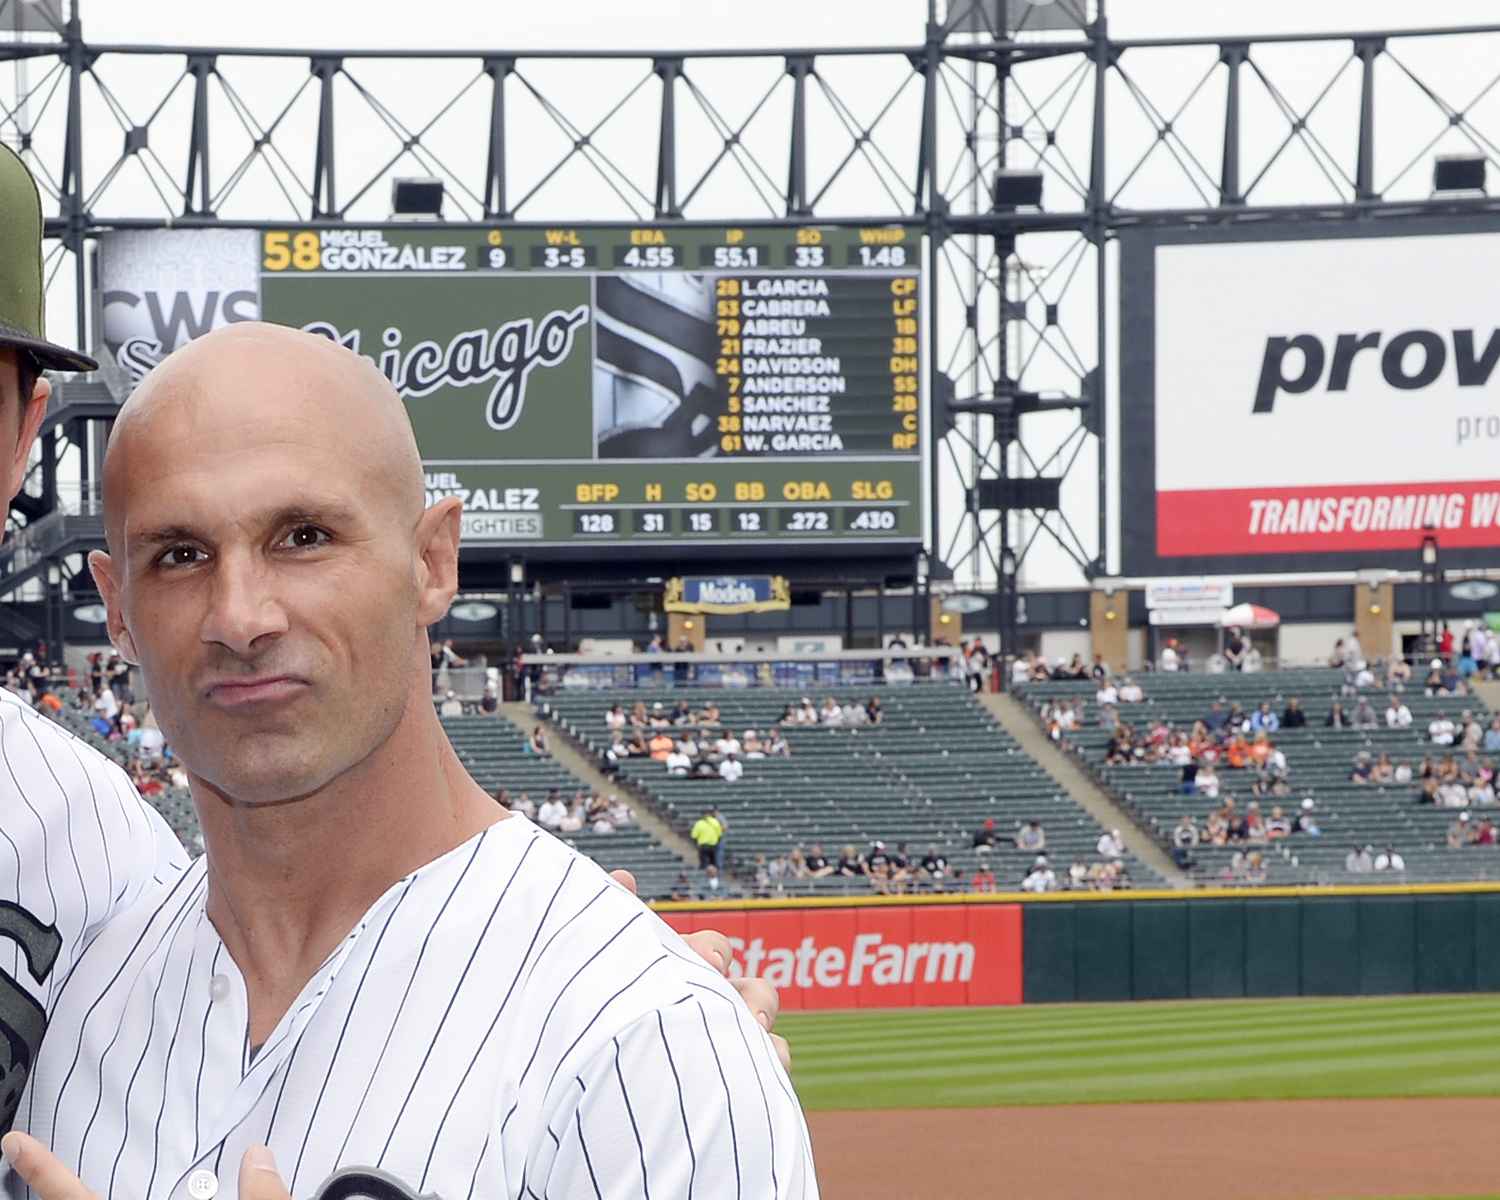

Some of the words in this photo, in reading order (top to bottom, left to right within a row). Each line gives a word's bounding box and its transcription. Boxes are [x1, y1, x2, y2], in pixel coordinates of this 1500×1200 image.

[320, 231, 387, 247] MIGUEL
[488, 231, 502, 244] G
[545, 230, 580, 245] W-L
[630, 229, 666, 245] ERA
[726, 229, 744, 244] IP
[796, 229, 822, 244] SO
[859, 229, 906, 244] WHIP
[264, 231, 320, 271] 58
[488, 248, 506, 268] 9
[544, 247, 585, 268] 3-5
[624, 247, 675, 267] 4.55
[714, 247, 758, 267] 55.1
[795, 246, 824, 267] 33
[859, 246, 906, 267] 1.48
[741, 279, 829, 296] L.GARCIA
[890, 278, 917, 295] CF
[741, 299, 830, 316] CABRERA
[892, 298, 917, 315] LF
[742, 318, 806, 336] ABREU
[894, 318, 917, 334] 1B
[721, 338, 741, 355] 21
[742, 338, 822, 355] FRAZIER
[892, 337, 917, 354] 3B
[716, 358, 740, 374] 24
[742, 357, 840, 374] DAVIDSON
[890, 357, 917, 373] DH
[1252, 328, 1500, 414] prov
[728, 377, 740, 394] 7
[742, 376, 846, 394] ANDERSON
[892, 376, 917, 393] SS
[742, 396, 831, 413] SANCHEZ
[892, 395, 917, 412] 2B
[742, 415, 833, 432] NARVAEZ
[901, 414, 917, 431] C
[721, 435, 741, 452] 61
[771, 434, 844, 451] GARCIA
[892, 433, 917, 450] RF
[576, 483, 620, 503] BFP
[645, 483, 663, 502] H
[685, 482, 717, 502] SO
[734, 481, 765, 501] BB
[782, 481, 832, 501] OBA
[851, 480, 894, 500] SLG
[580, 514, 614, 533] 128
[642, 513, 664, 532] 31
[689, 513, 712, 532] 15
[738, 512, 761, 531] 12
[786, 511, 829, 530] .272
[850, 511, 895, 530] .430
[1248, 492, 1466, 536] TRANSFORMING
[699, 581, 756, 604] Modelo
